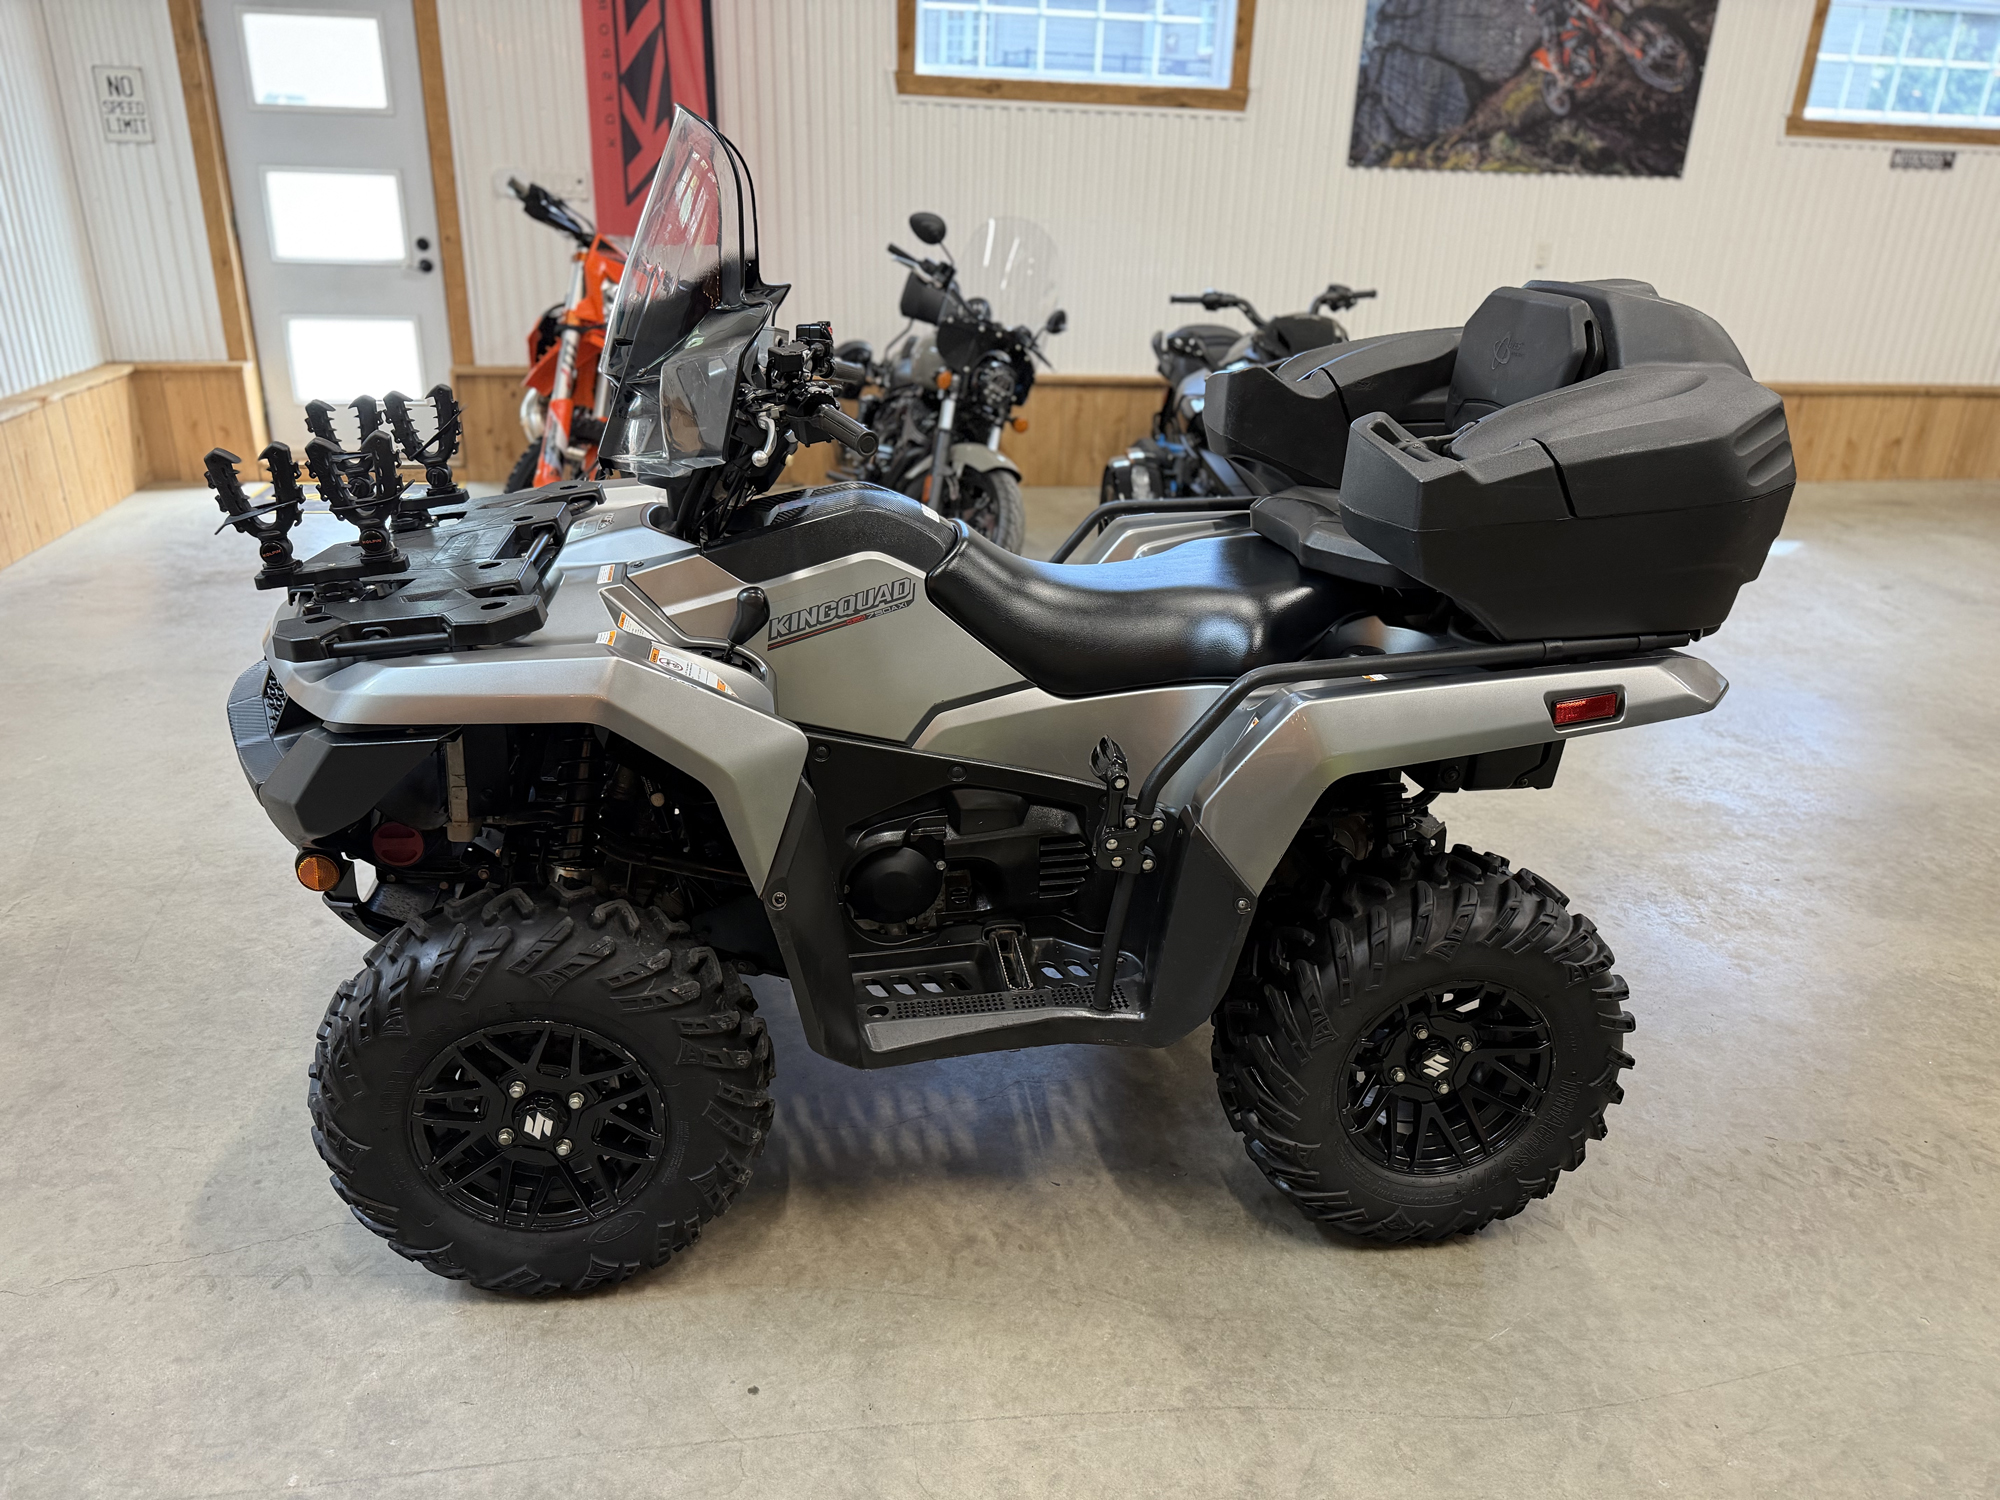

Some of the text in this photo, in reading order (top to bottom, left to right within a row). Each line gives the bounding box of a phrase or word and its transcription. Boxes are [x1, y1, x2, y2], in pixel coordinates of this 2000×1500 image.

[106, 75, 134, 98] NO
[103, 100, 146, 115] SPEED
[106, 117, 147, 134] LIMIT
[769, 577, 914, 640] KINGQUAD
